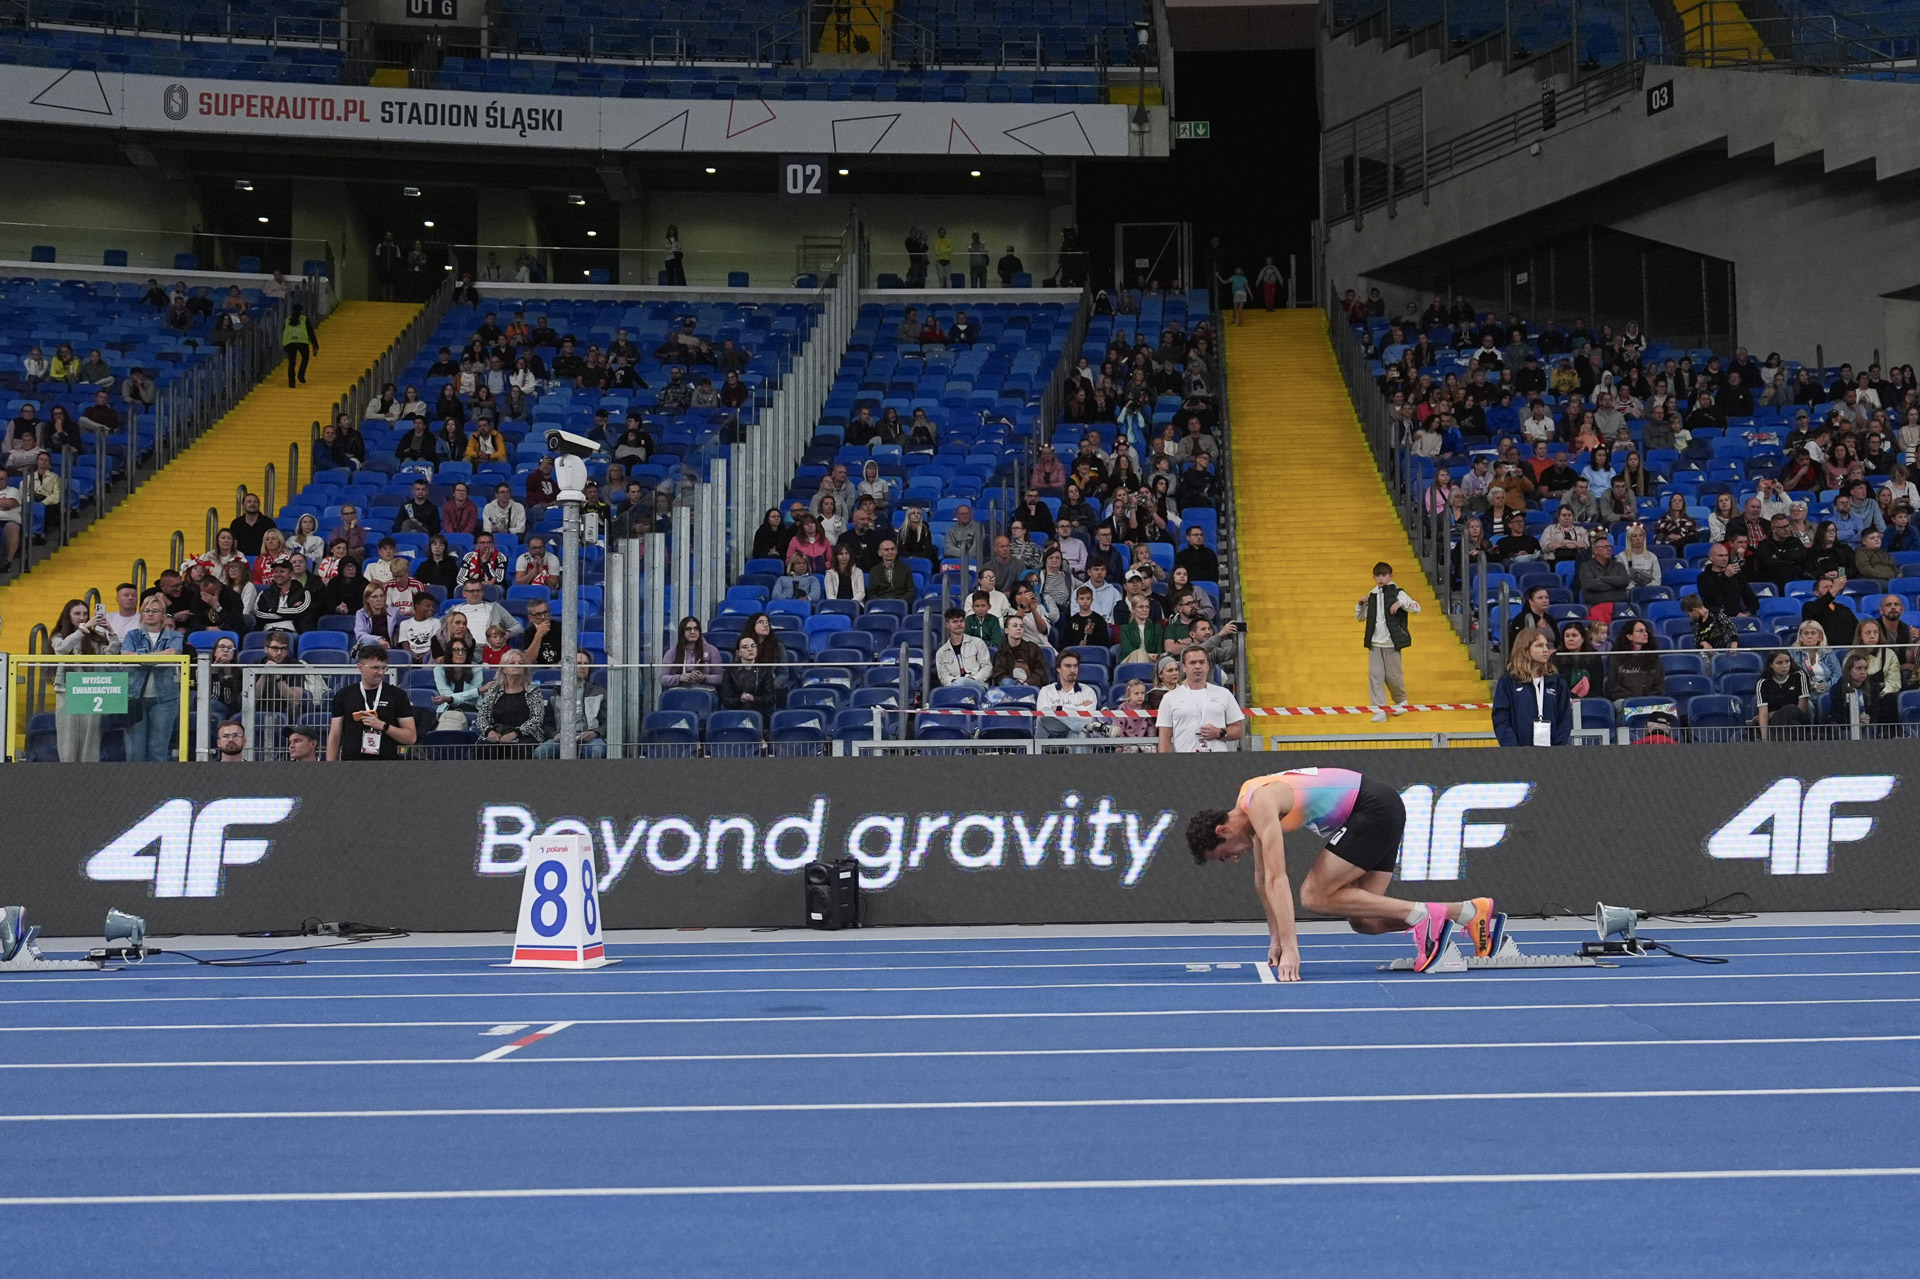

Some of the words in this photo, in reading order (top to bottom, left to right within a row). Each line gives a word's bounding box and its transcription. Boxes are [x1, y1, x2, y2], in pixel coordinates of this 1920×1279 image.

[441, 0, 453, 15] G
[199, 92, 370, 122] SUPERAUTO.PL
[381, 101, 478, 128] STADION
[485, 101, 563, 138] ŚLĄSKI
[1651, 86, 1669, 110] 03
[786, 164, 822, 194] 02
[82, 675, 112, 685] WYJŚCIE
[92, 696, 104, 712] 2
[848, 794, 1175, 889] gravity
[1707, 776, 1896, 875] 4F
[86, 798, 294, 897] 4F
[546, 845, 569, 854] polanik
[530, 860, 568, 938] 8
[581, 859, 597, 936] 8
[1479, 918, 1487, 952] NITRO
